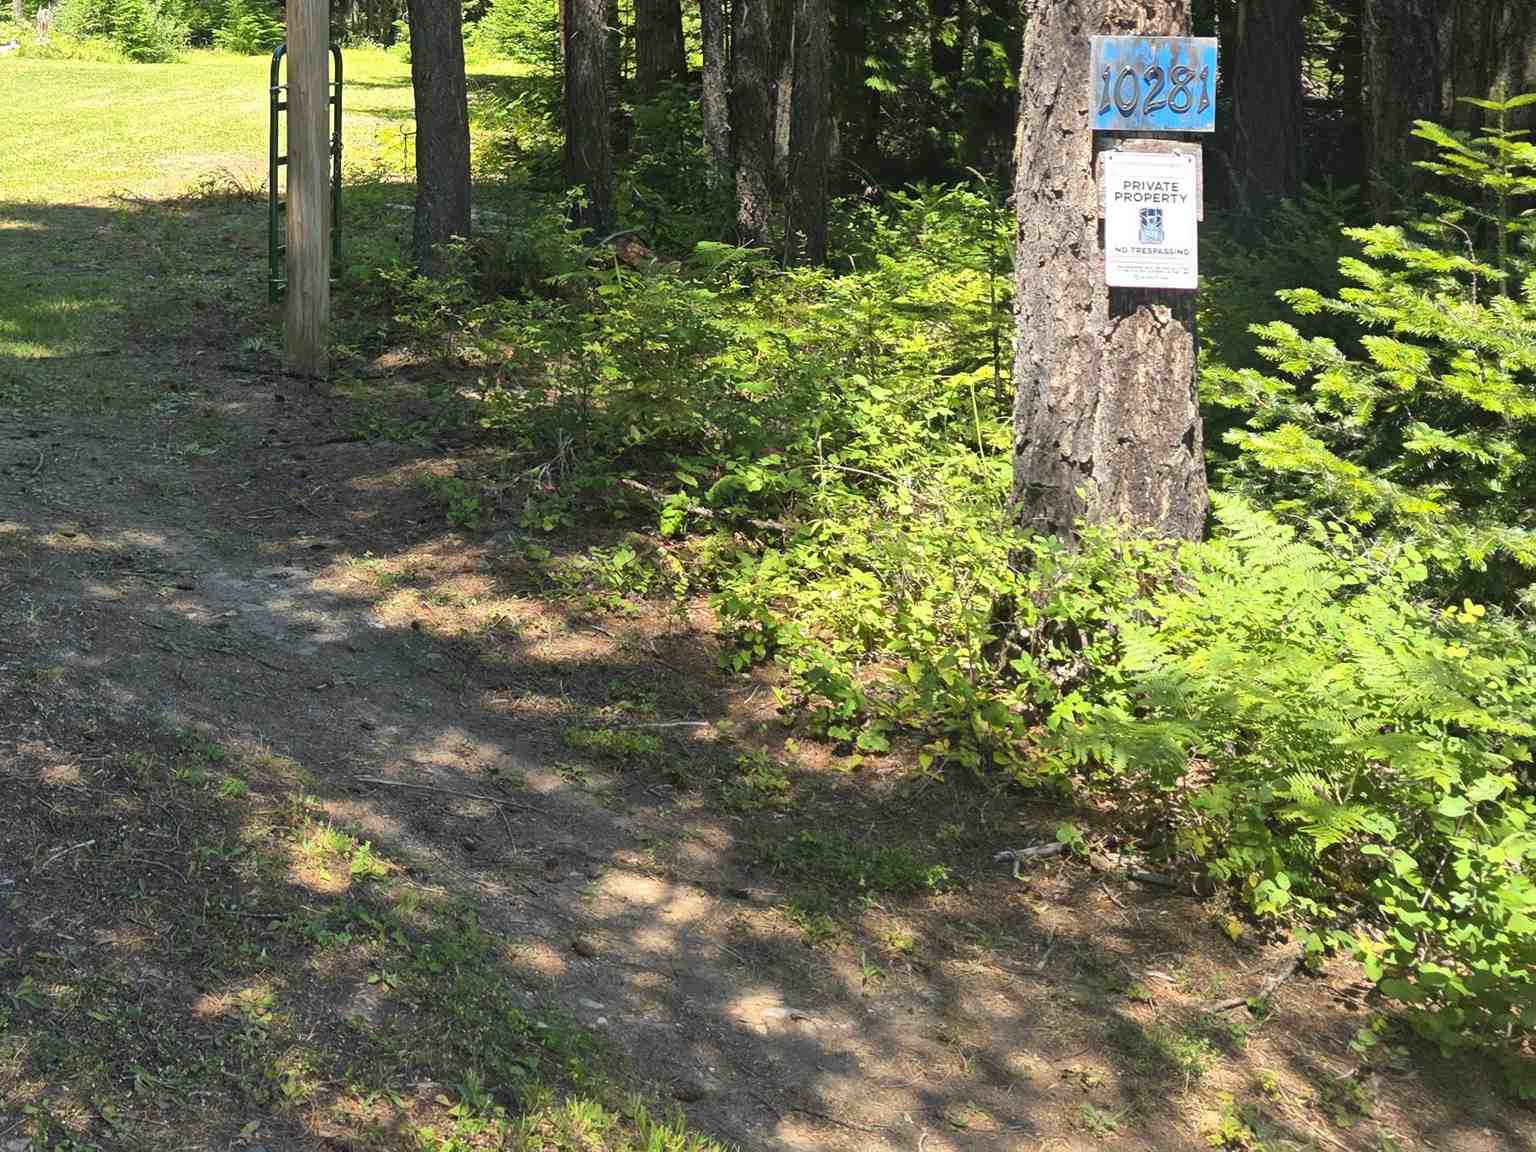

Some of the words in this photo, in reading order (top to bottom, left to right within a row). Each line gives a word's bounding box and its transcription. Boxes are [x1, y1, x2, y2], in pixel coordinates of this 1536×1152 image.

[1097, 63, 1210, 117] 10281
[1123, 180, 1179, 192] PRIVATE
[1114, 191, 1188, 204] PROPERTY
[1114, 246, 1128, 254] NO
[1131, 246, 1190, 256] TRESPASSING
